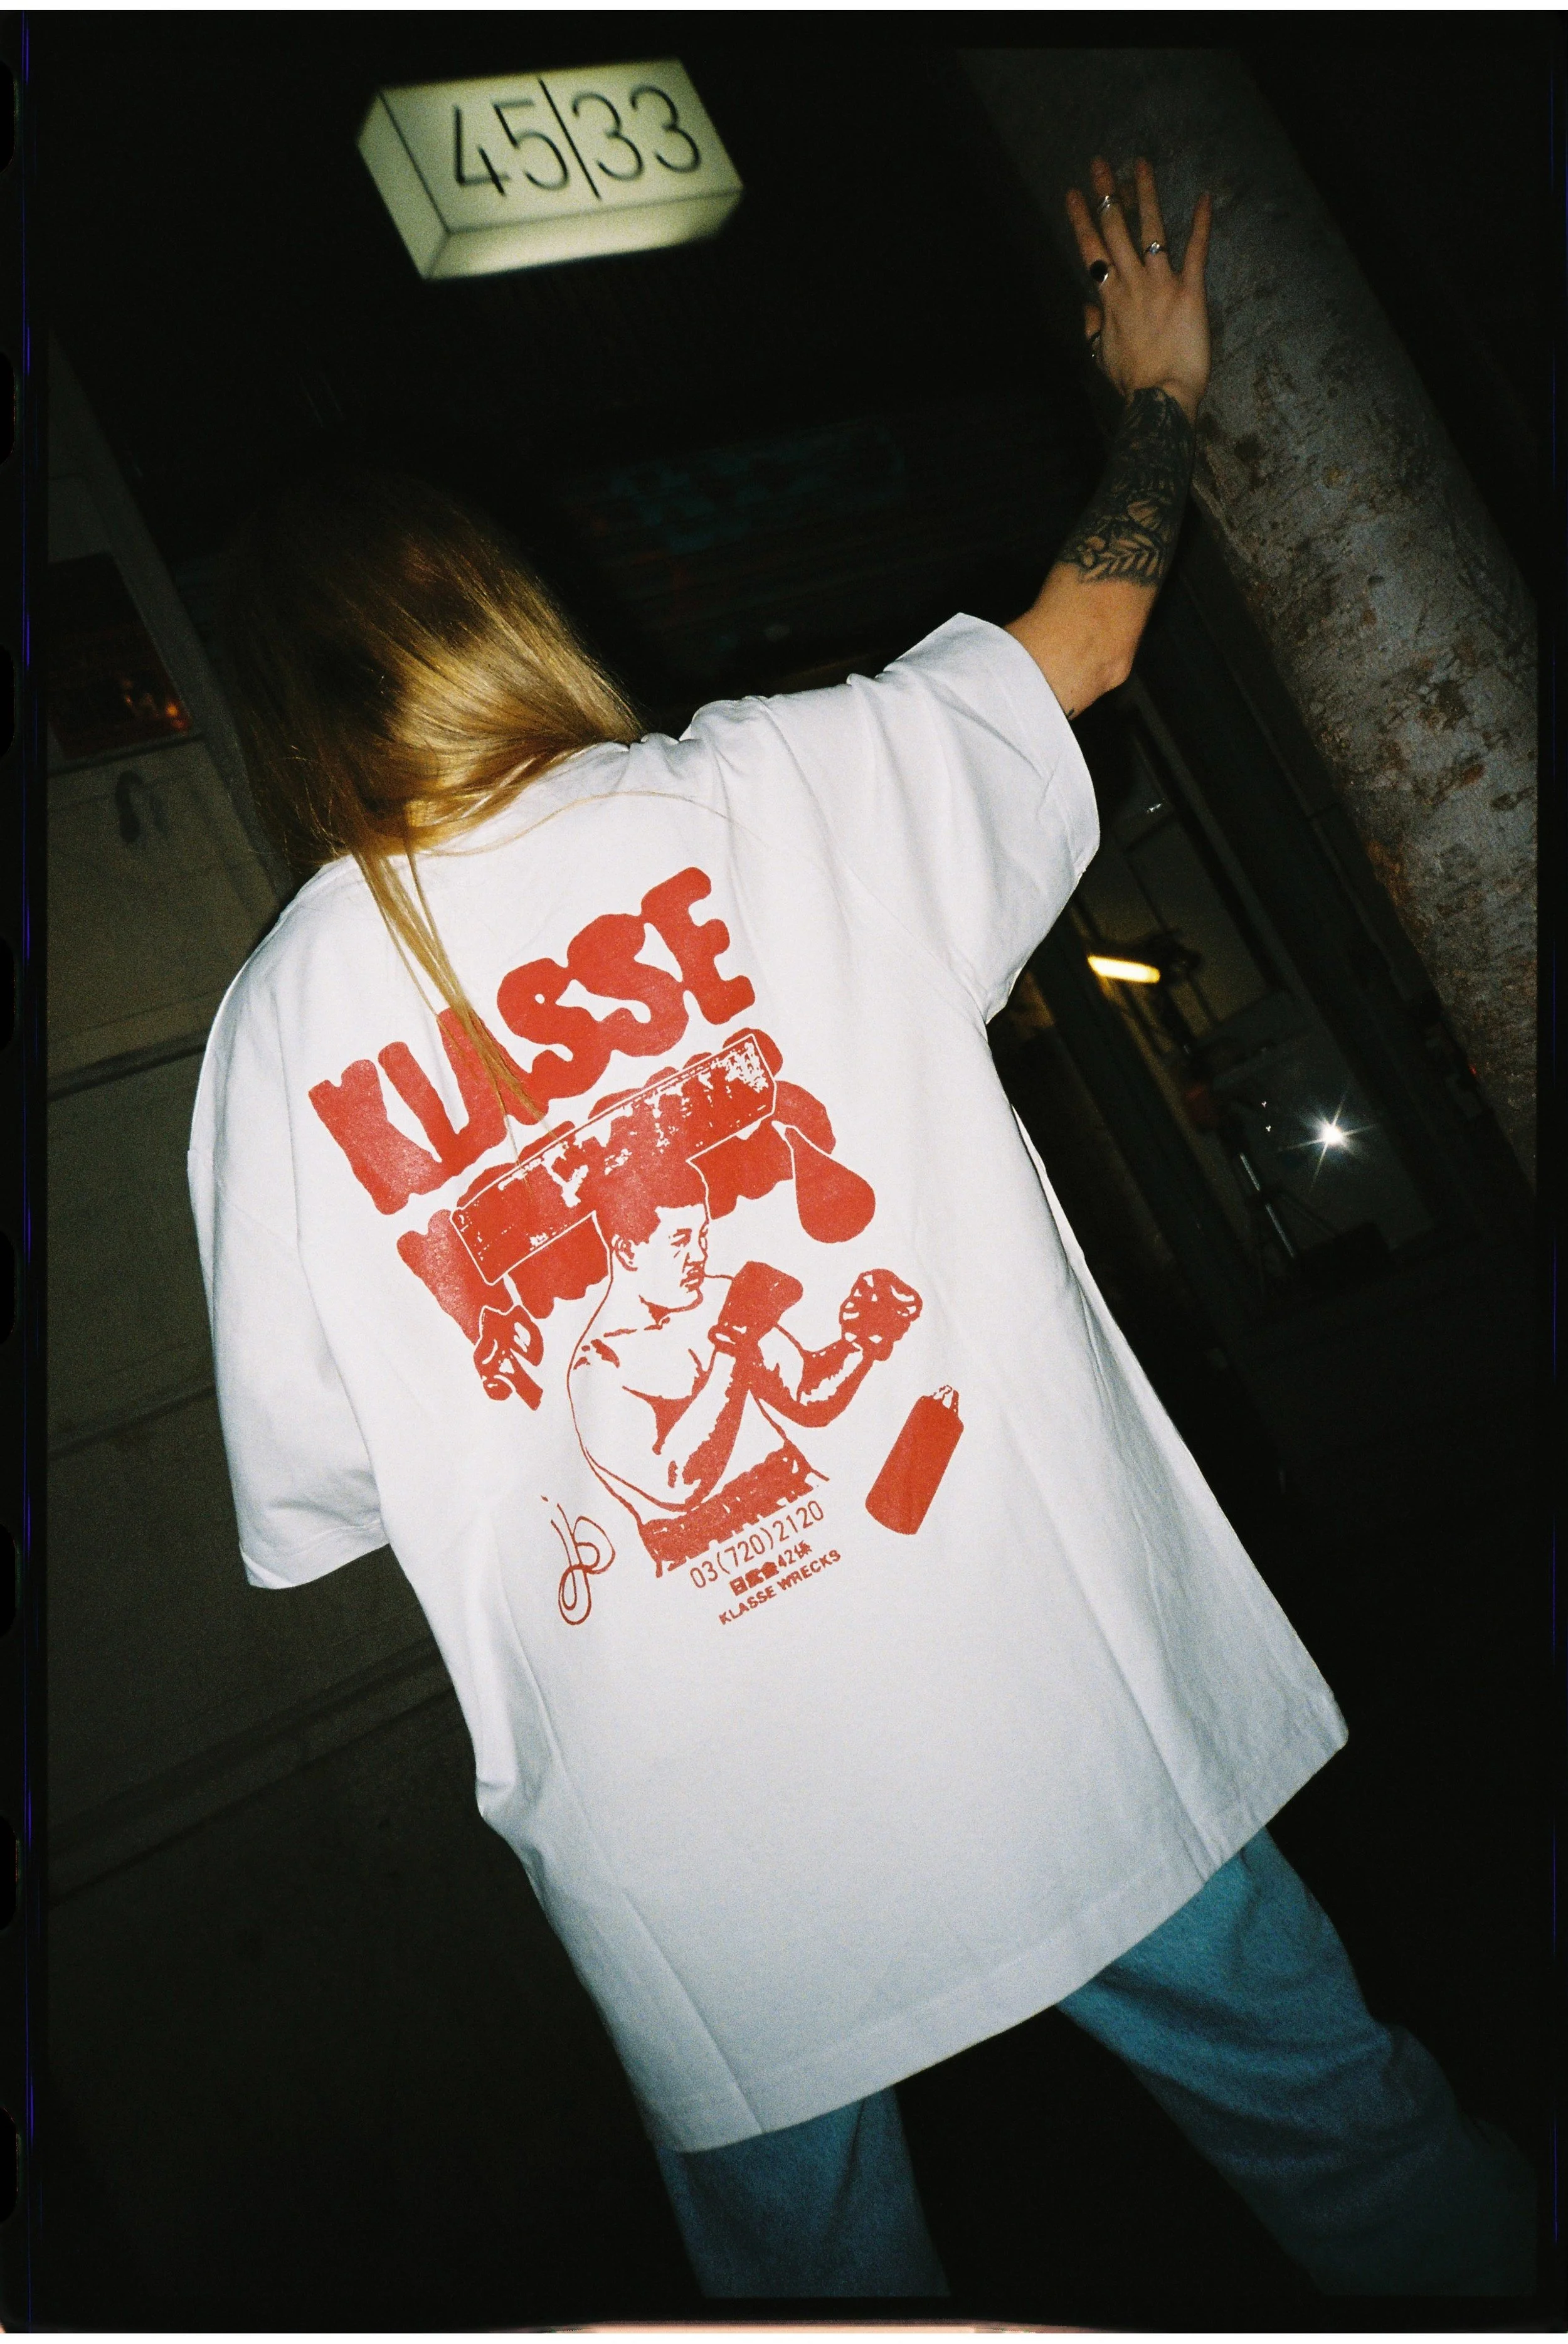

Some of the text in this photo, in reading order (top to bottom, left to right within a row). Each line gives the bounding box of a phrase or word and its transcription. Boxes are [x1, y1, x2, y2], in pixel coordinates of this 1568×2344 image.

[309, 867, 755, 1215] KLASSE
[690, 1500, 825, 1589] 03(720)2120
[718, 1550, 842, 1625] KLASSE WRECKS
